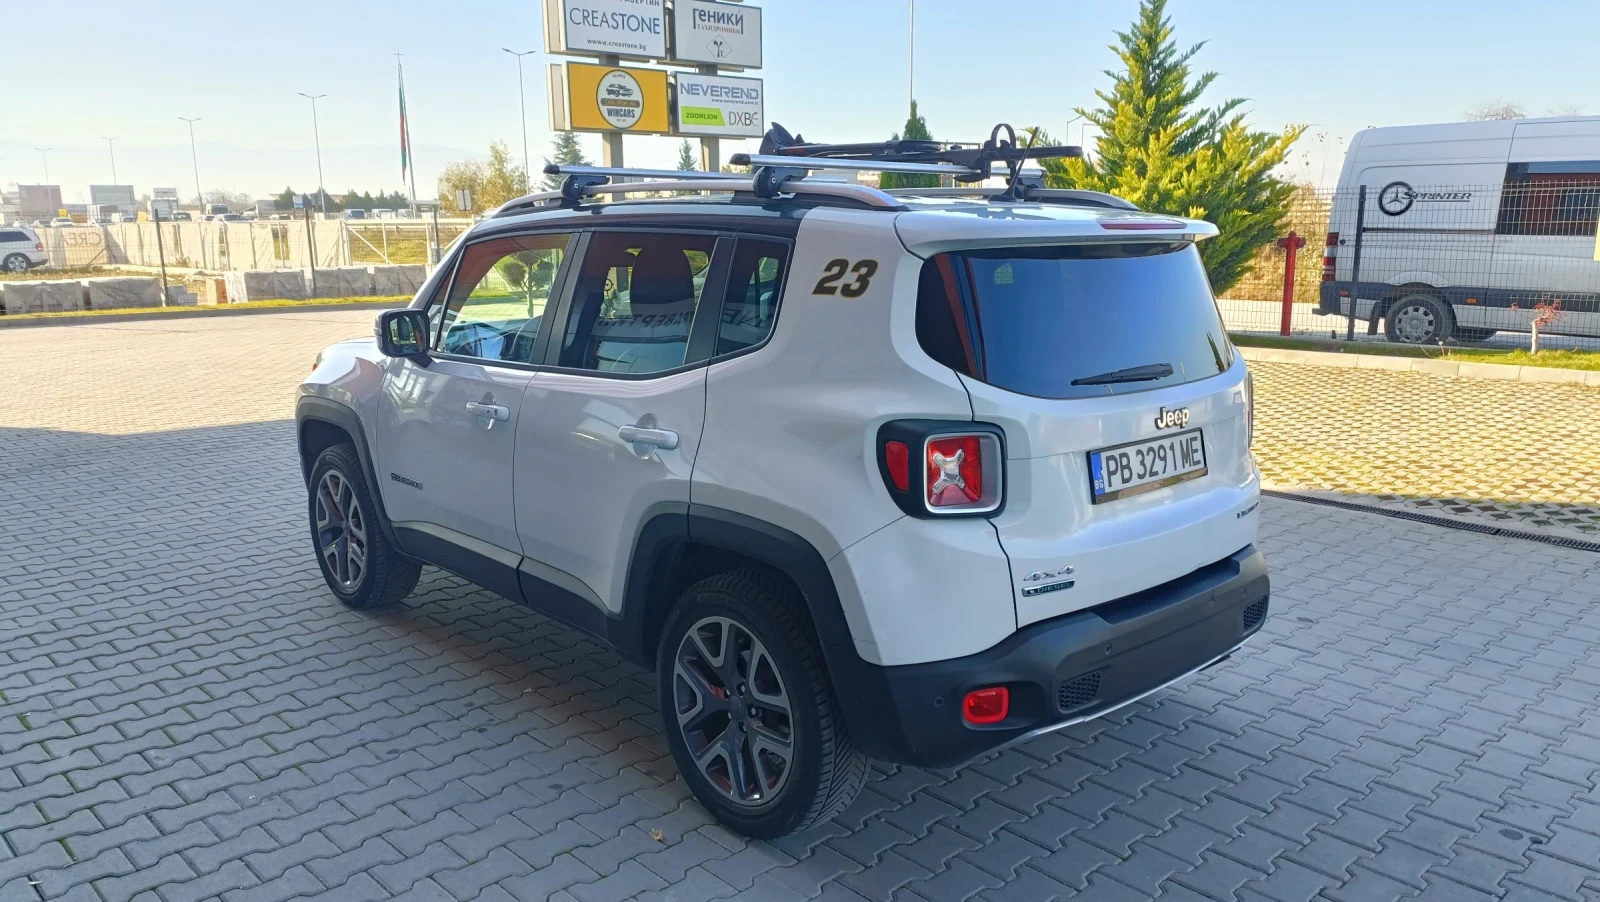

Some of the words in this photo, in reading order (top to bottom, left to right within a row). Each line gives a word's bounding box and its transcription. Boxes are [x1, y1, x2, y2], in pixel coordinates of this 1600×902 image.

[569, 8, 660, 34] CREASTONE
[680, 82, 759, 100] NEVEREND
[606, 107, 636, 119] WINCARS
[685, 112, 718, 120] ZOOMLION
[810, 258, 879, 299] 23
[1155, 407, 1190, 429] Jeep
[1135, 441, 1178, 480] 3291
[1094, 479, 1104, 490] BG
[1037, 582, 1073, 593] DIESEL
